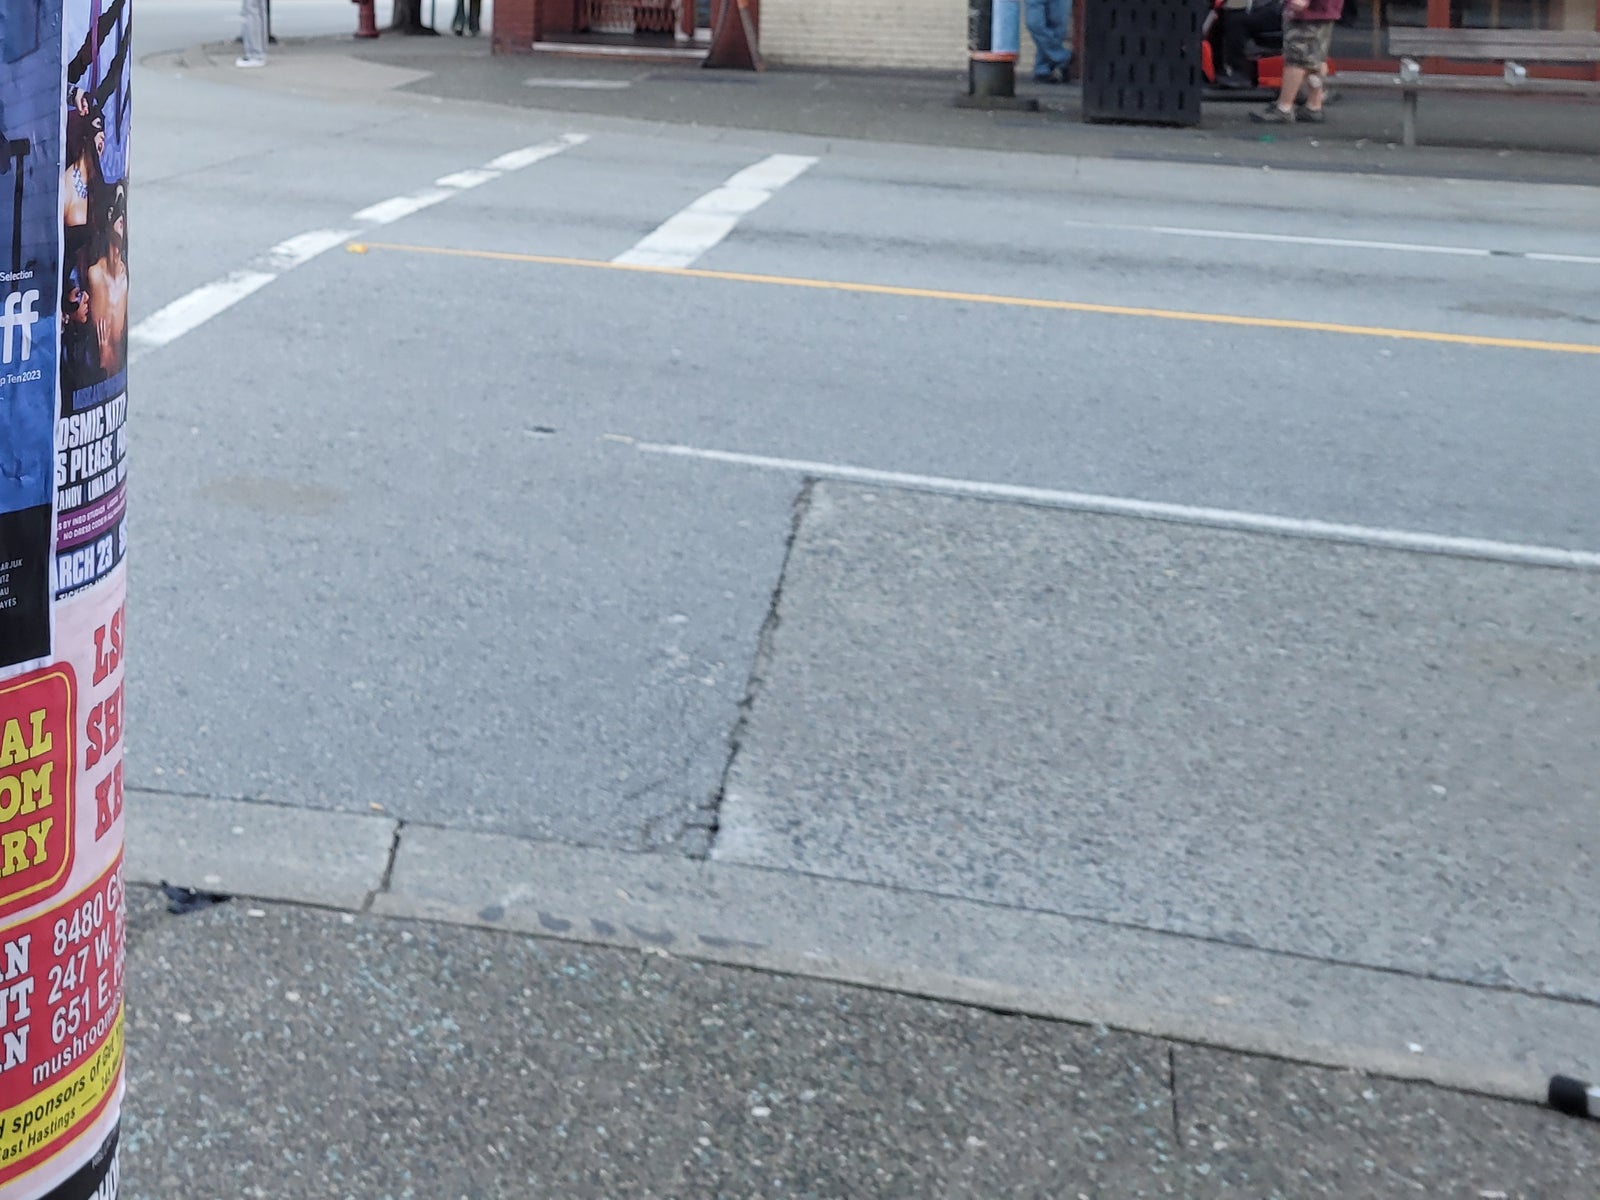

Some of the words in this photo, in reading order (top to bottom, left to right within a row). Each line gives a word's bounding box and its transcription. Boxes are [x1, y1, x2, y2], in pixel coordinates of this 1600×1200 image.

[0, 270, 34, 282] Selection
[70, 434, 113, 483] PLEASE
[63, 530, 73, 540] NO
[96, 534, 113, 574] 23
[53, 891, 103, 956] 8480
[48, 945, 90, 1005] 247
[94, 921, 112, 968] W.
[51, 986, 90, 1044] 651
[97, 969, 111, 1010] E.
[11, 1075, 85, 1134] sponsors
[89, 1055, 101, 1082] of
[27, 1109, 76, 1149] Hastings
